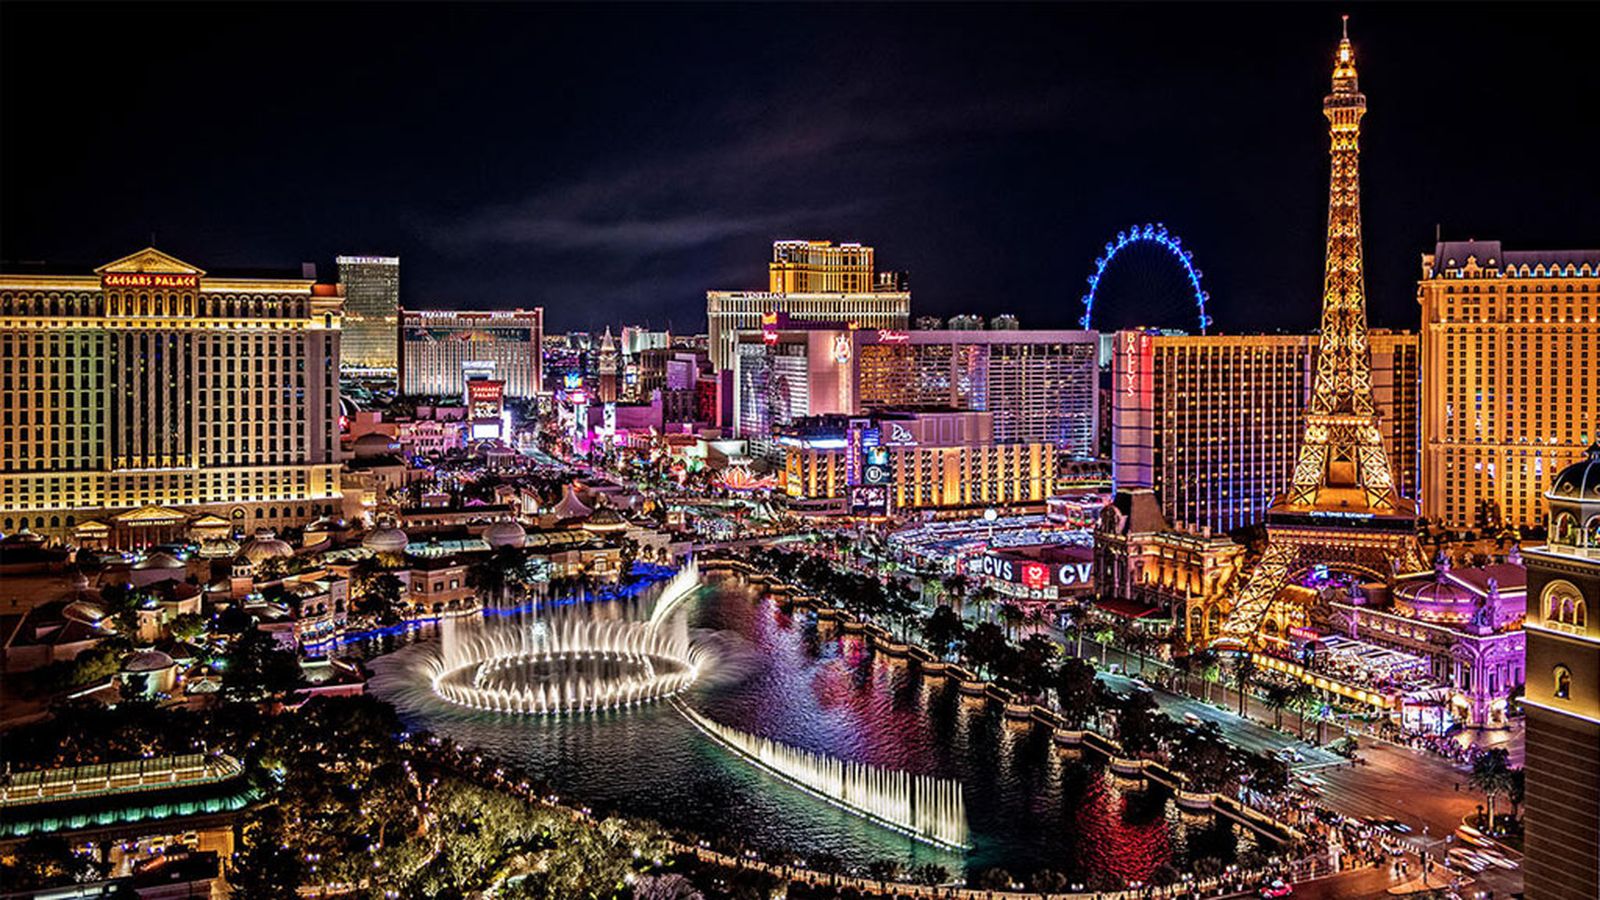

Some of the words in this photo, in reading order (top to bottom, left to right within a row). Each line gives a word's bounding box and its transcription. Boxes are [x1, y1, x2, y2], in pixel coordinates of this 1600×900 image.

[105, 276, 152, 286] CAESARS
[155, 276, 195, 286] PALACE
[983, 556, 1012, 580] CVS
[1059, 564, 1092, 585] CV
